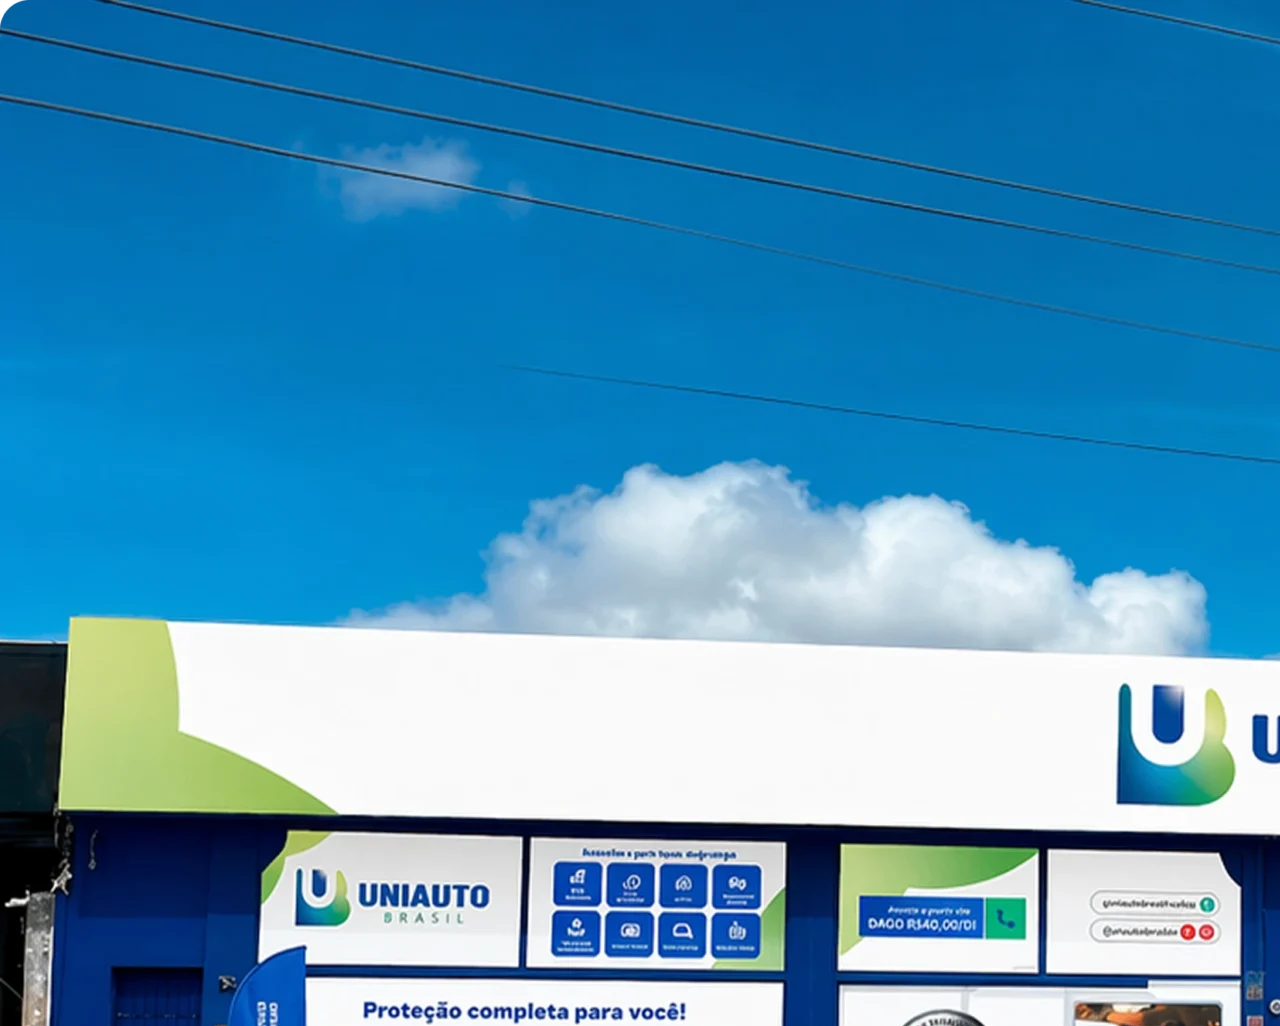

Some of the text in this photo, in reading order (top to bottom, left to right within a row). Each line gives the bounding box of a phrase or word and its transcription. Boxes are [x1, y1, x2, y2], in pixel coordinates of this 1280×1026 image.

[359, 883, 489, 908] UNIAUTO
[384, 912, 463, 924] BRASIL
[364, 1002, 685, 1024] Proteção completa para você!
